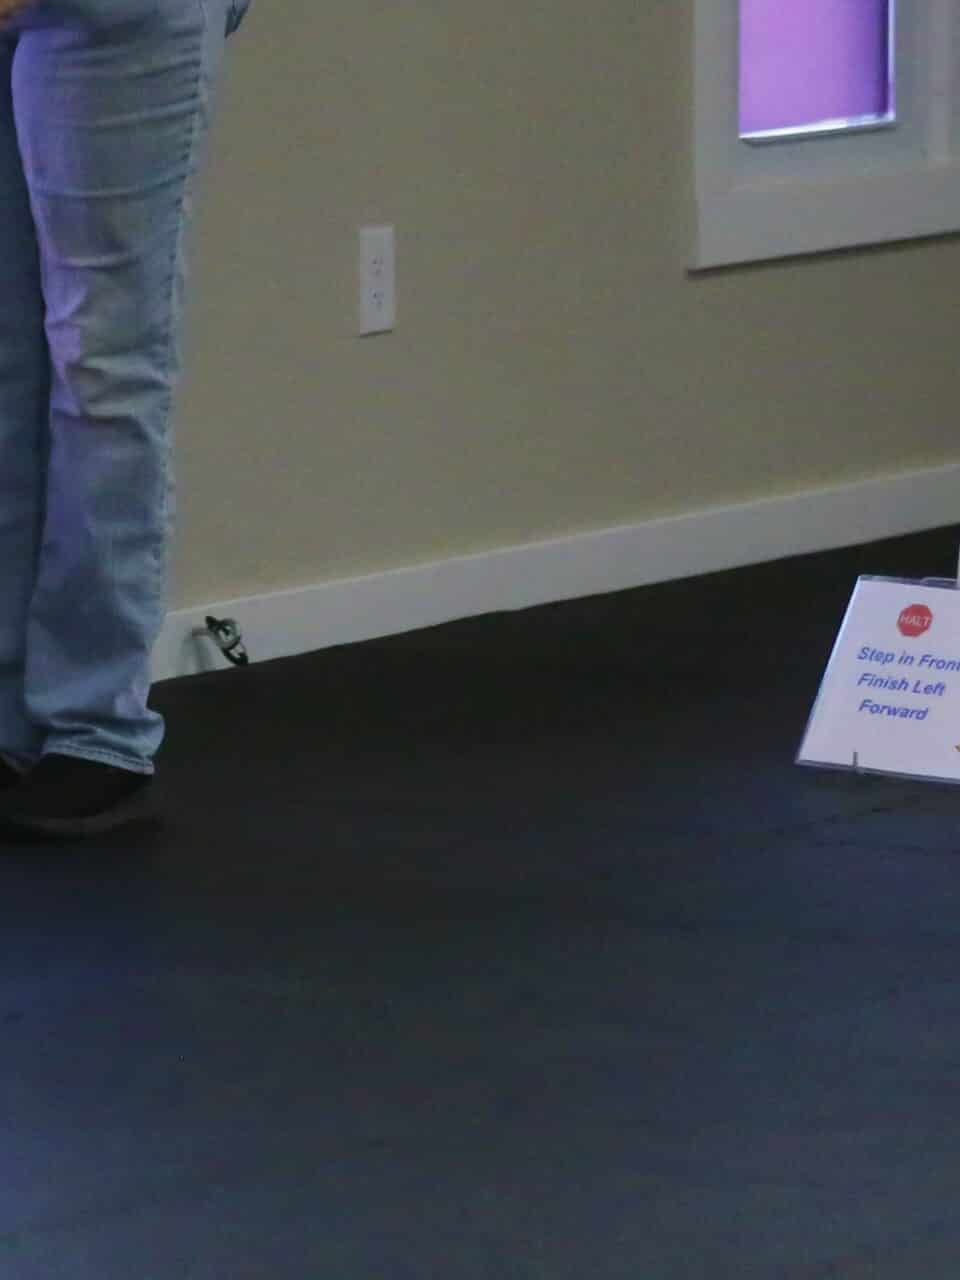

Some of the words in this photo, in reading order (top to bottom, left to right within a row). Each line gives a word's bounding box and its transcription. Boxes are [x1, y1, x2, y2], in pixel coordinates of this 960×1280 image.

[899, 614, 930, 627] HALT
[857, 646, 895, 665] Step
[898, 650, 915, 666] in
[857, 673, 909, 692] Finish
[912, 680, 946, 697] Left
[858, 699, 929, 721] Forward
